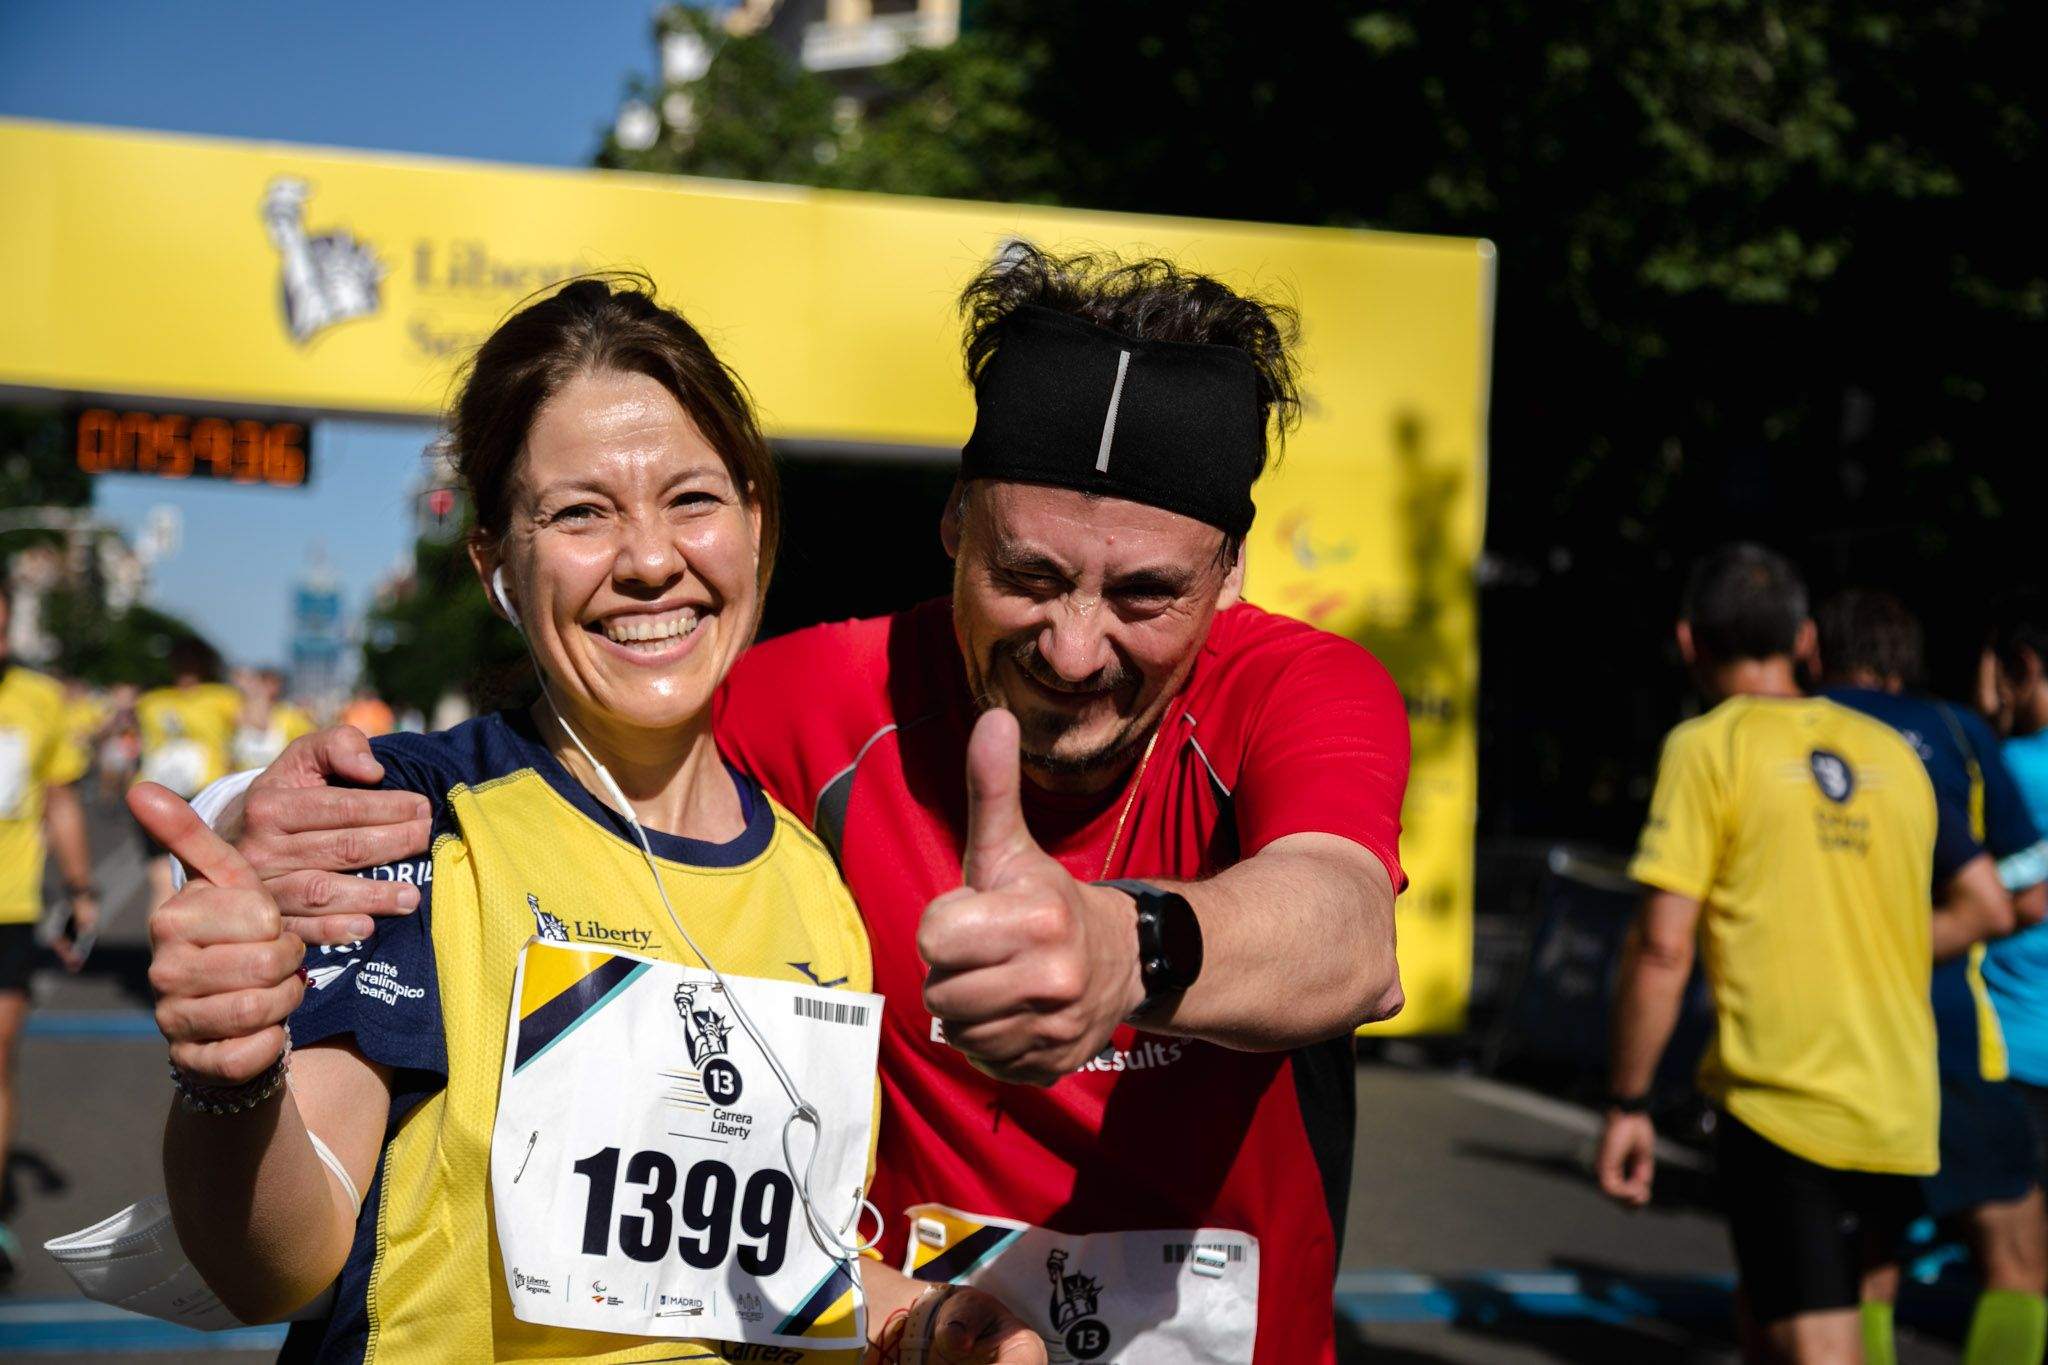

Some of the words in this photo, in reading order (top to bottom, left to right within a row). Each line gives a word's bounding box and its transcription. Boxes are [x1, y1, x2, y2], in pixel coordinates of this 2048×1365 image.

[575, 920, 652, 950] Liberty
[357, 970, 425, 998] aralímpico
[709, 1068, 735, 1096] 13
[713, 1108, 753, 1125] Carrera
[710, 1121, 751, 1140] Liberty
[573, 1146, 795, 1277] 1399
[526, 1276, 549, 1287] Liberty
[670, 1296, 703, 1308] MADRID
[1075, 1329, 1100, 1350] 13
